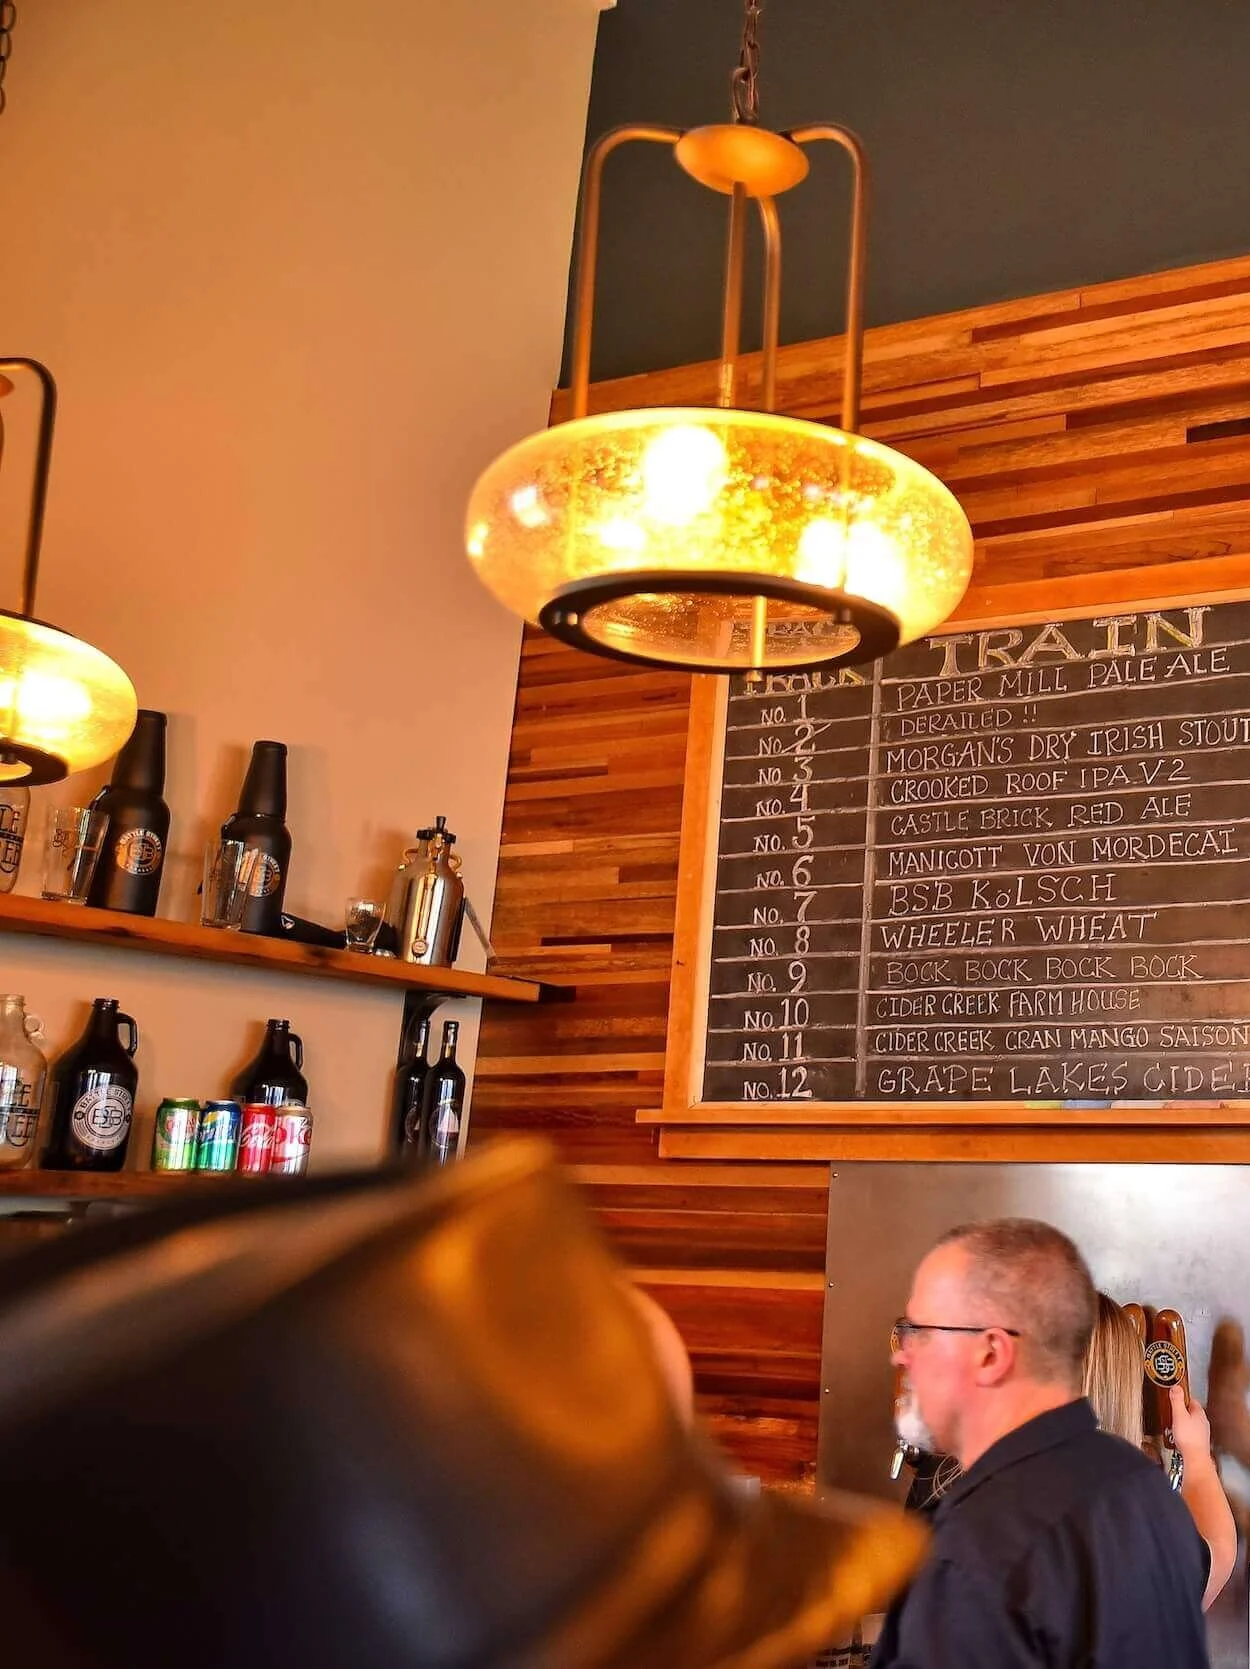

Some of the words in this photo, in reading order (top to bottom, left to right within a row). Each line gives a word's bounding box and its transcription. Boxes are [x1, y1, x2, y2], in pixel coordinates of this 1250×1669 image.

[926, 607, 1211, 677] TRAIN
[897, 678, 983, 711] PAPER
[999, 672, 1068, 698] MILL
[1089, 660, 1156, 688] PALE
[1165, 648, 1230, 676] ALE
[796, 695, 814, 722] 1
[901, 707, 1013, 736] DERAILED
[1029, 730, 1076, 762] DRY
[1087, 722, 1164, 754] IRISH
[794, 757, 813, 782] 3
[789, 783, 814, 812] 4
[891, 775, 988, 803] CROOKED
[1007, 771, 1066, 793] ROOF
[891, 808, 974, 837] CASTLE
[982, 804, 1052, 829] BRICK
[1069, 800, 1124, 825] RED
[1140, 795, 1191, 817] ALE
[754, 834, 785, 853] NO.
[793, 816, 814, 846] 5
[889, 845, 1000, 876] MANICOTT
[1026, 841, 1076, 867] VON
[1092, 829, 1238, 860] MORDECAI
[755, 870, 784, 888] NO.
[792, 856, 812, 886] 6
[753, 905, 783, 925] NO.
[795, 891, 817, 921] 7
[889, 881, 953, 916] BSB
[749, 937, 780, 956] NO.
[794, 926, 810, 953] 8
[880, 918, 1016, 949] WHEELER
[1036, 912, 1158, 941] WHEAT
[748, 973, 776, 992] NO.
[788, 961, 809, 994] 9
[887, 961, 951, 985] BOCK
[965, 959, 1031, 983] BOCK
[1045, 956, 1116, 980] BOCK
[1130, 955, 1202, 979] BOCK
[781, 999, 809, 1028] 10
[876, 994, 936, 1019] CIDER
[941, 993, 1000, 1016] CREEK
[782, 1035, 803, 1059] 11
[875, 1030, 931, 1053] CIDER
[934, 1029, 994, 1052] CREEK
[1006, 1029, 1062, 1051] CRAN
[1070, 1026, 1149, 1049] MANGO
[1161, 1025, 1249, 1047] SAISON
[777, 1067, 811, 1098] 12
[877, 1065, 994, 1094] GRAPE
[1010, 1065, 1128, 1096] LAKES
